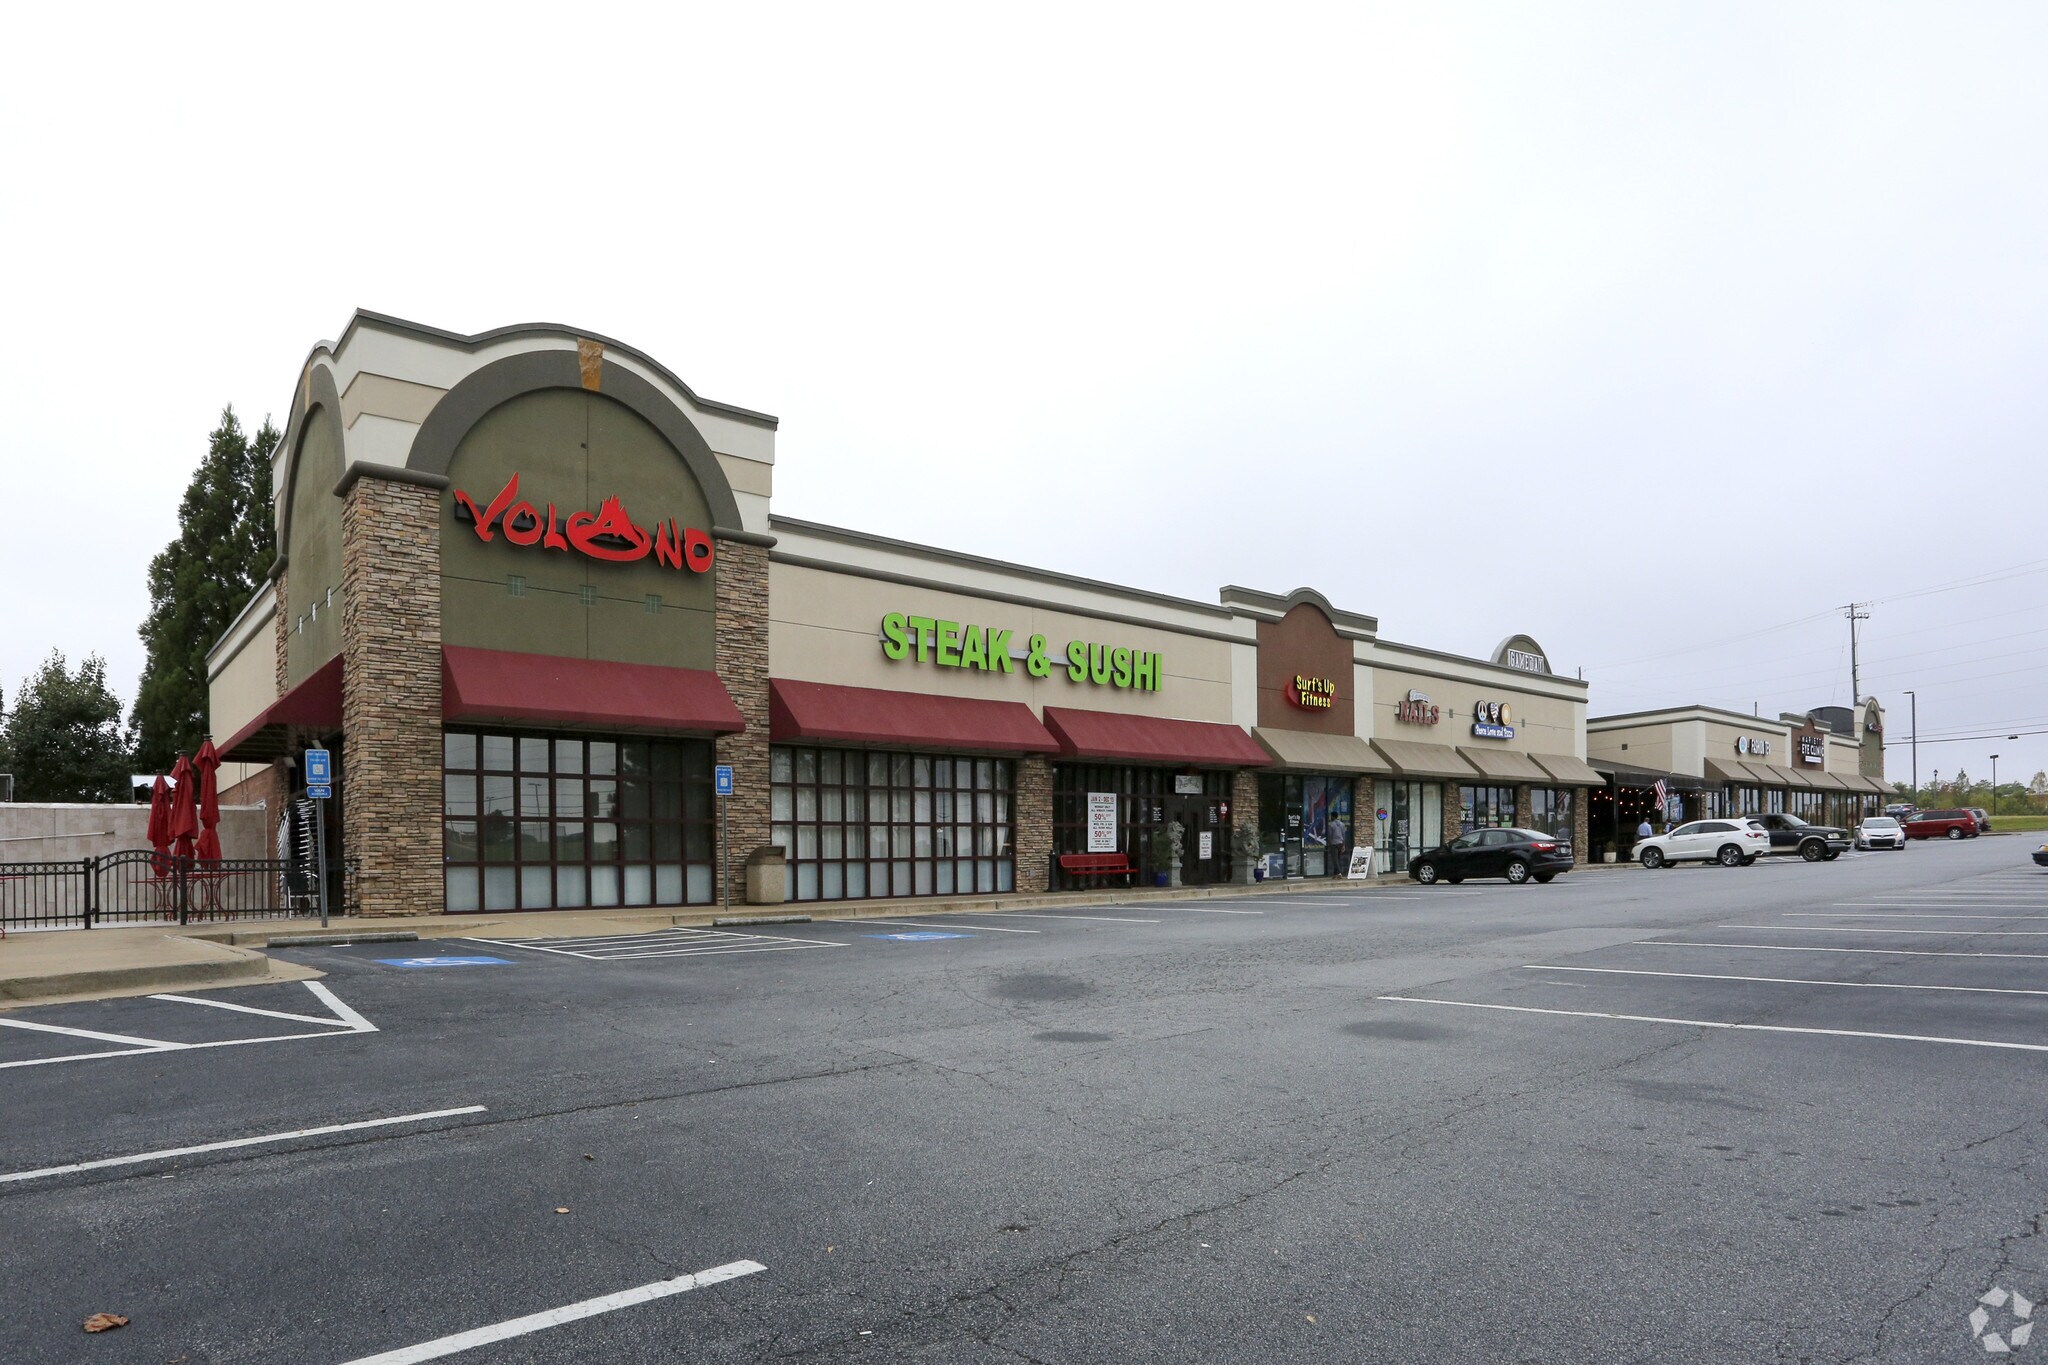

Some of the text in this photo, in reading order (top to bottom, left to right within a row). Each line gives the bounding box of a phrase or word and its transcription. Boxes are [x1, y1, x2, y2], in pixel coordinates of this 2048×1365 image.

[454, 472, 714, 573] VOLCANO
[882, 612, 1162, 692] STEAK & SUSHI
[1296, 675, 1334, 696] Surf's Up
[1301, 691, 1331, 707] Fitness
[1399, 701, 1439, 725] NAILS
[1802, 744, 1810, 755] EYE
